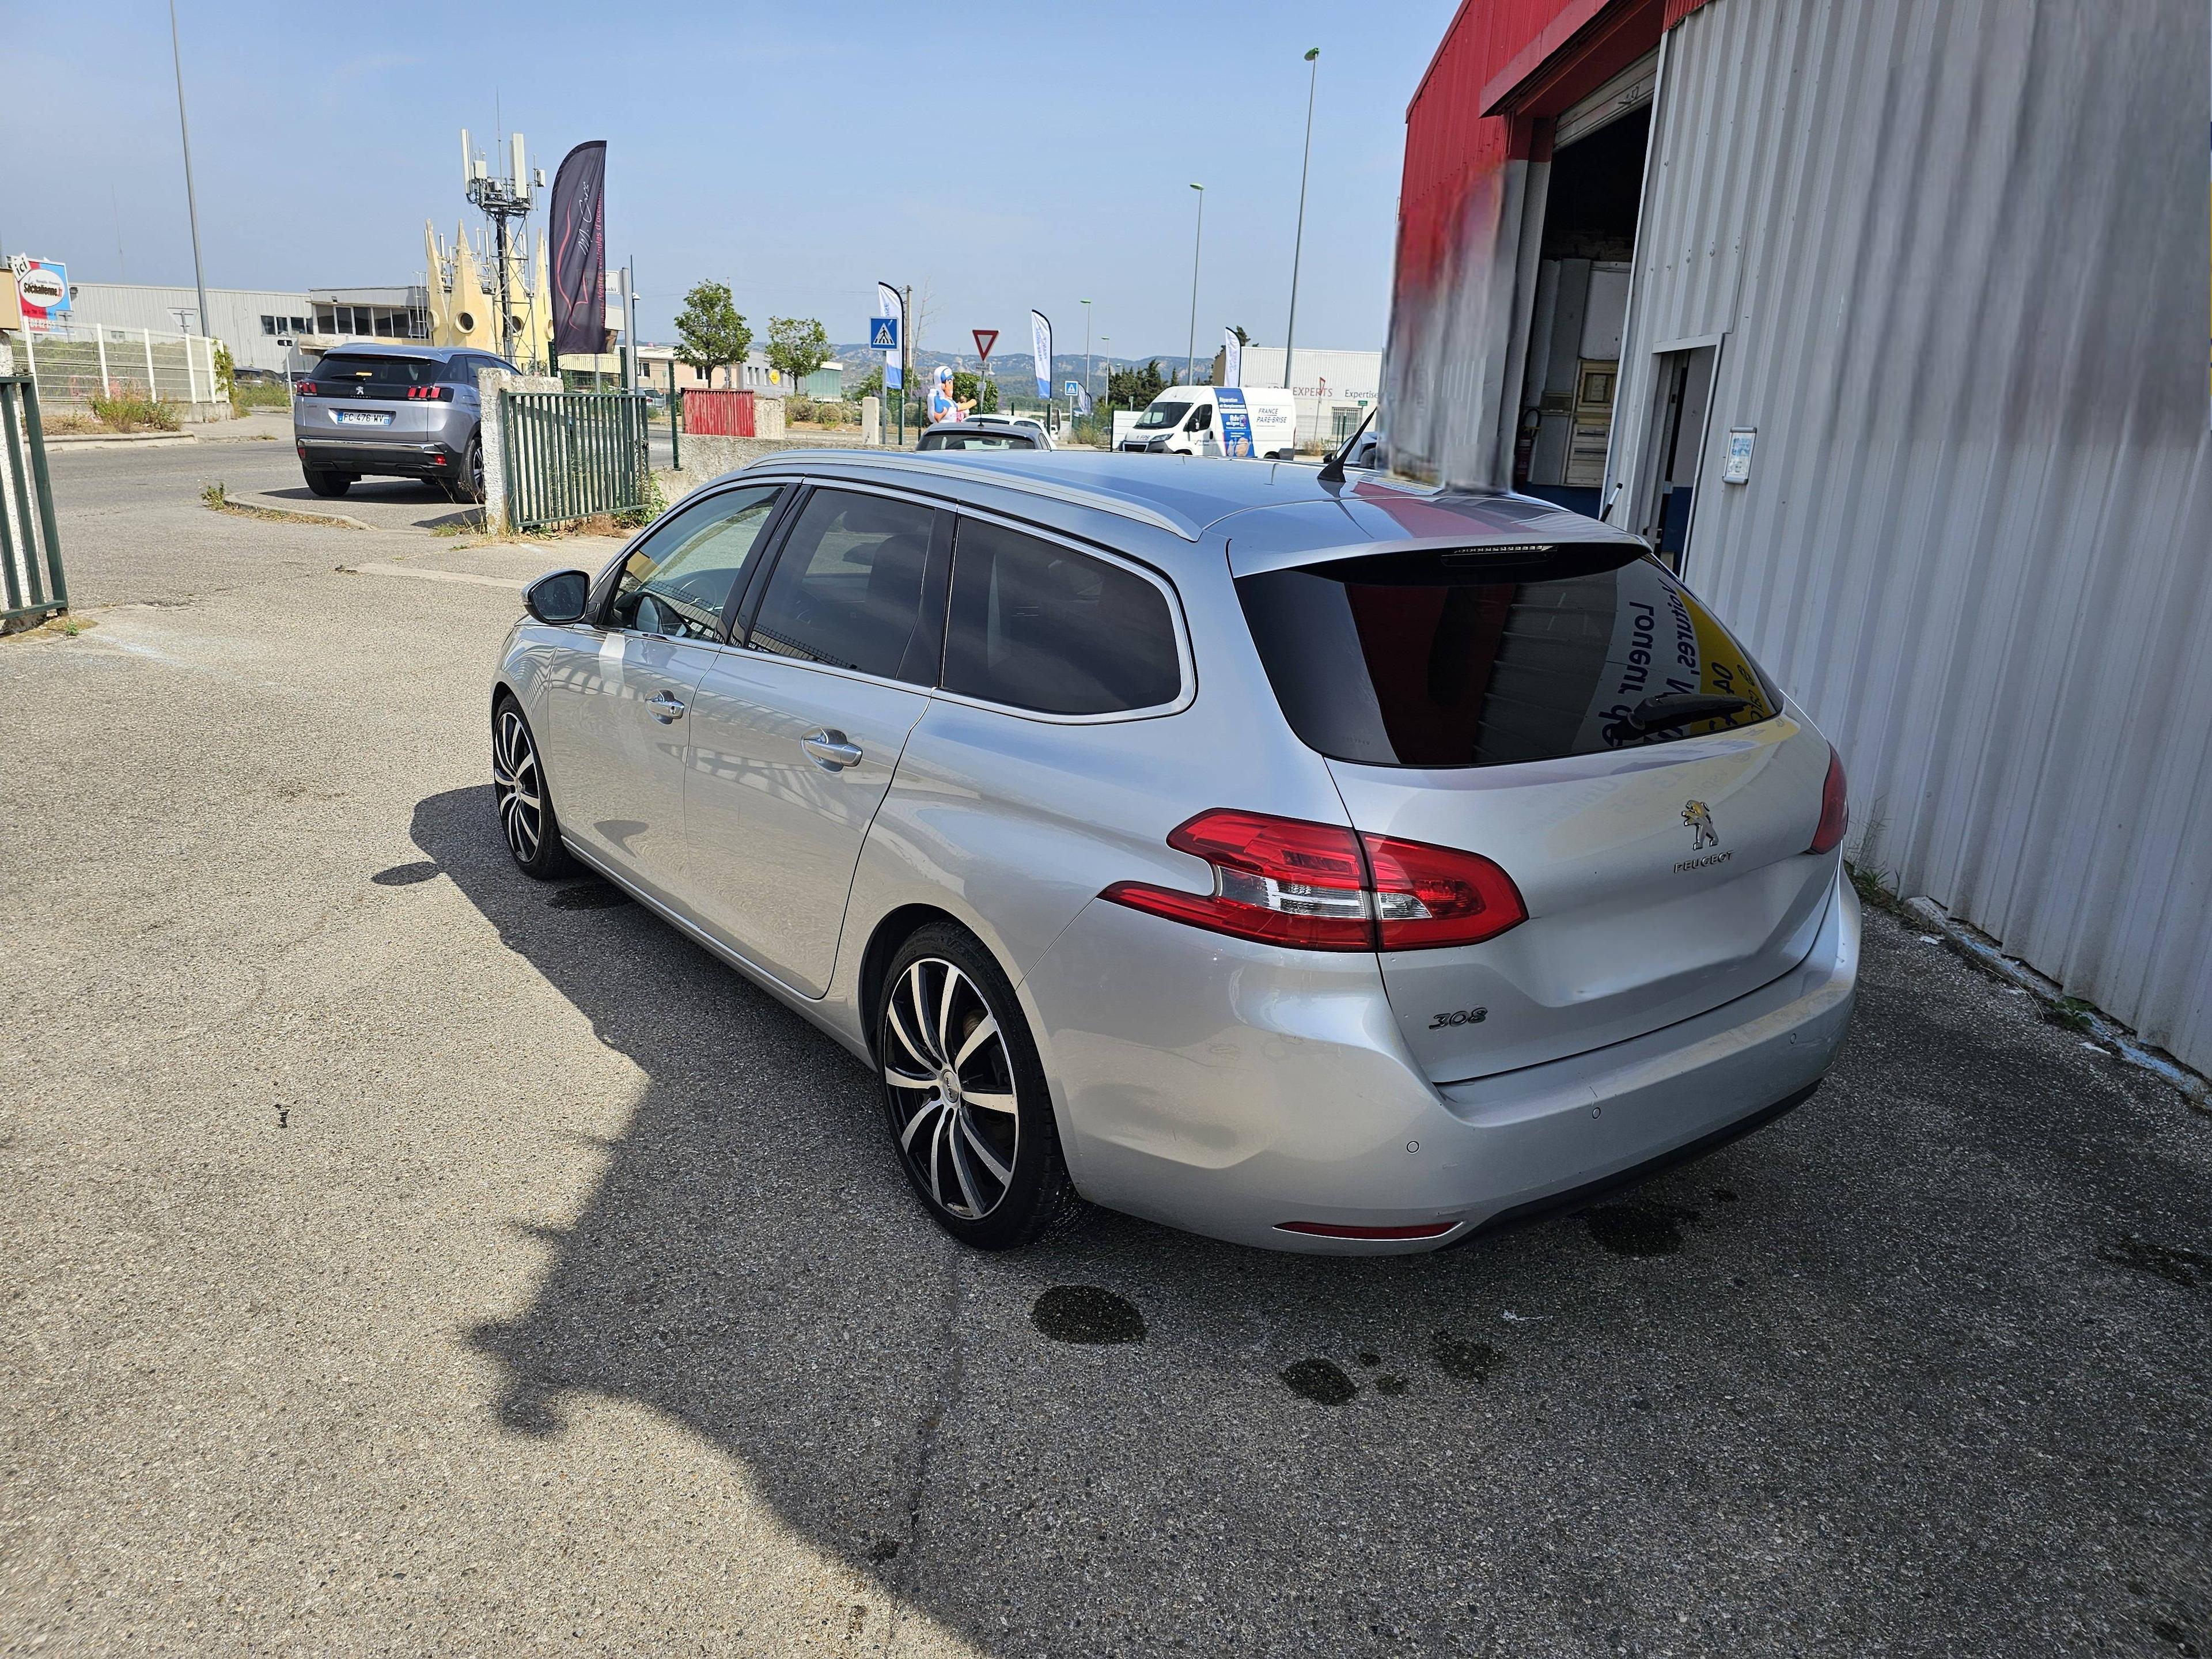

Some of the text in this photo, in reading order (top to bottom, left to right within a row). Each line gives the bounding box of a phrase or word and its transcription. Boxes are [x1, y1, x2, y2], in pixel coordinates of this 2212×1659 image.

[15, 257, 28, 276] ici
[1293, 387, 1332, 397] EXPERTS
[1673, 850, 1736, 873] PEUGEOT
[1429, 1007, 1488, 1030] 308
